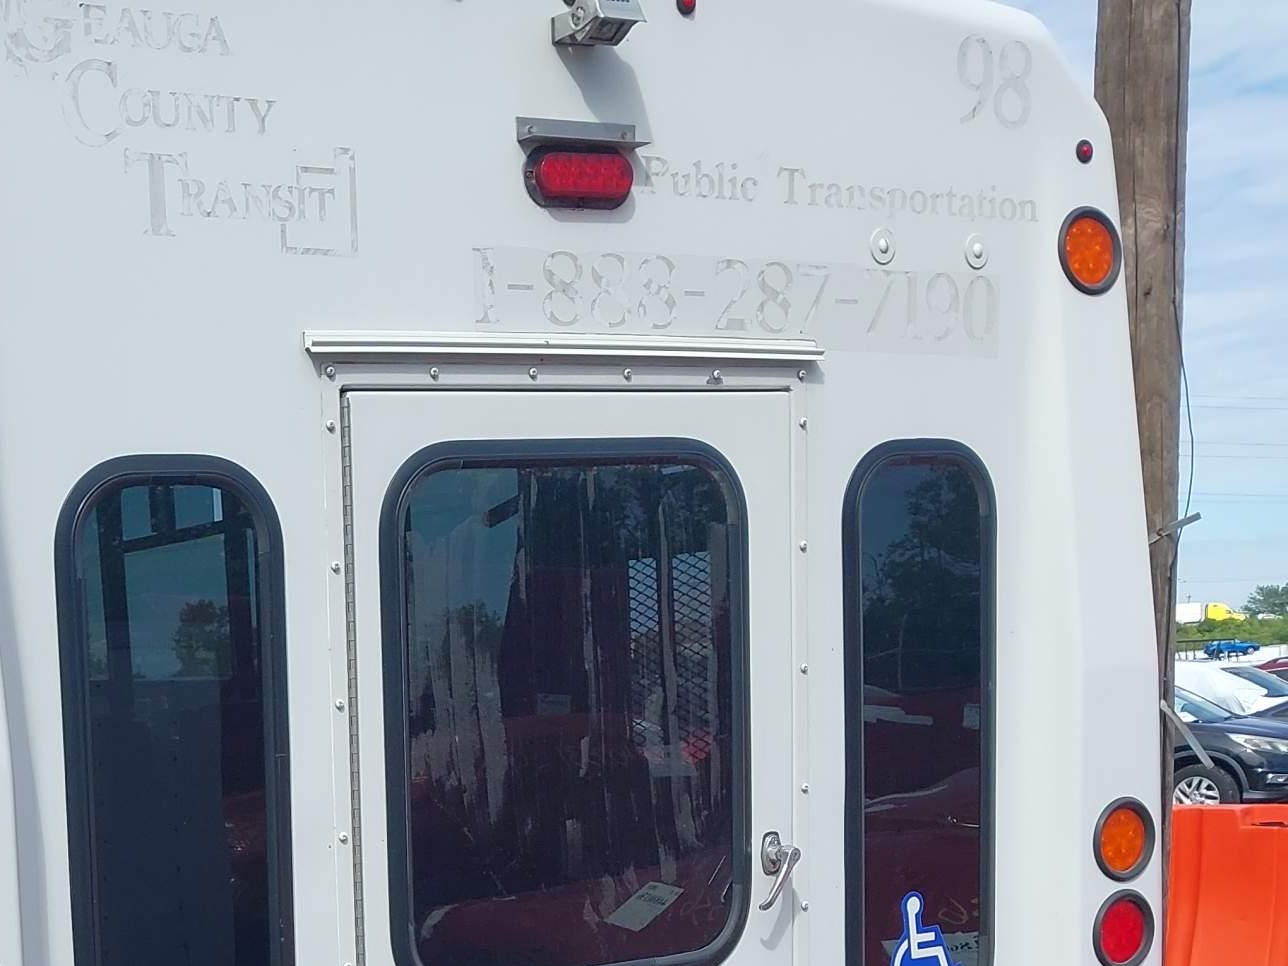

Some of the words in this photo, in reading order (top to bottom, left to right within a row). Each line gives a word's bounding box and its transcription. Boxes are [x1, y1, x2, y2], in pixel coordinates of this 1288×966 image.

[62, 58, 276, 147] COUNTY
[957, 33, 1033, 130] 98
[123, 147, 336, 236] TRANSIT
[640, 155, 759, 203] Public
[776, 166, 1040, 223] Transportation
